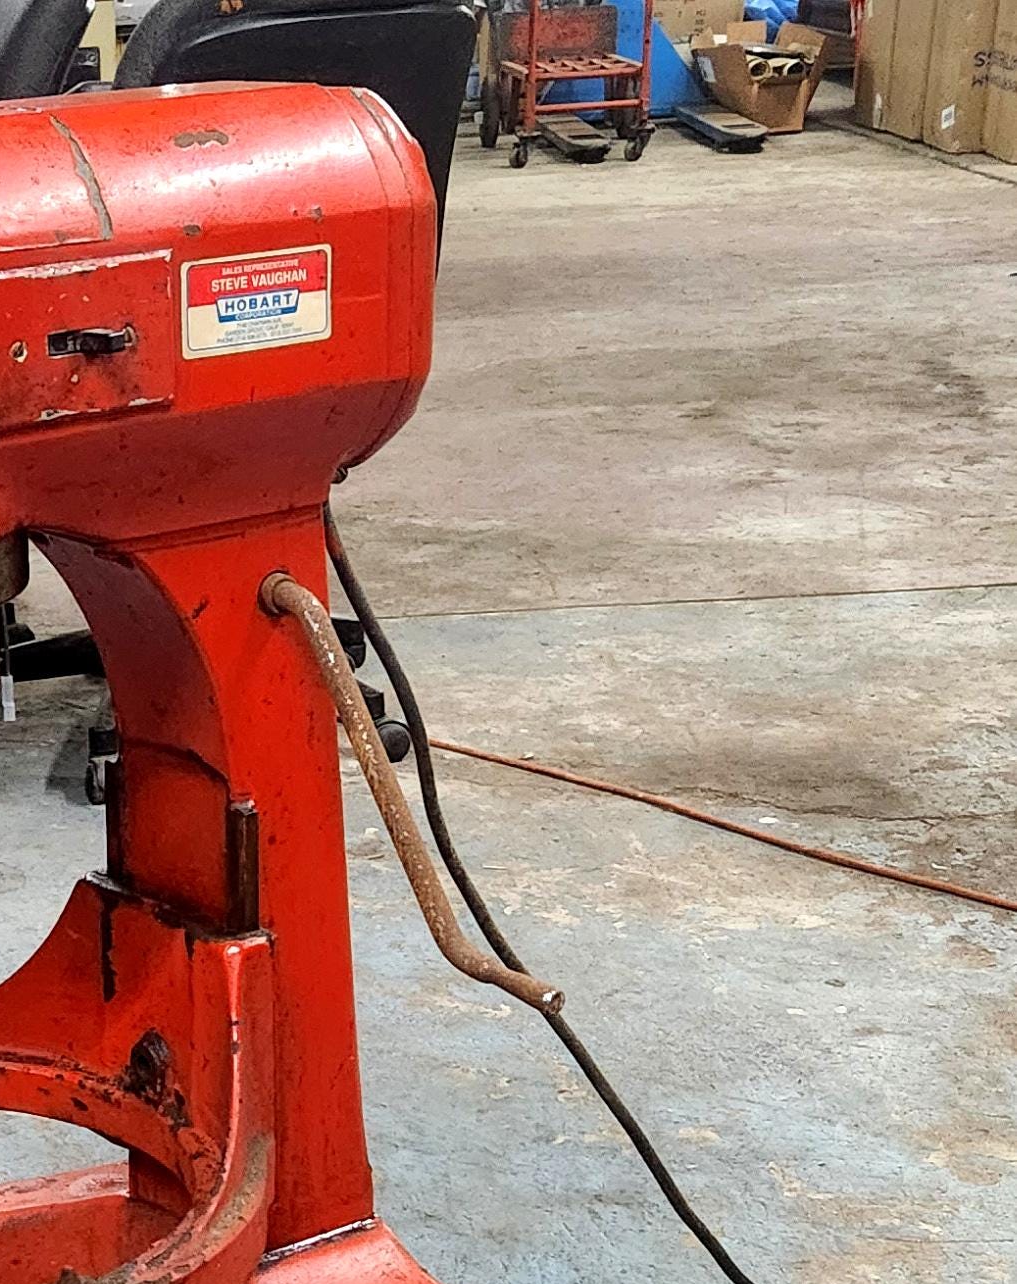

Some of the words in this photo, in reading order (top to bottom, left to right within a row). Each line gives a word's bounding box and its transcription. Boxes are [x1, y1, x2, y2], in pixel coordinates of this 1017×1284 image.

[211, 276, 248, 292] STEVE
[251, 269, 307, 287] VAUGHAN
[224, 293, 293, 313] HOBART
